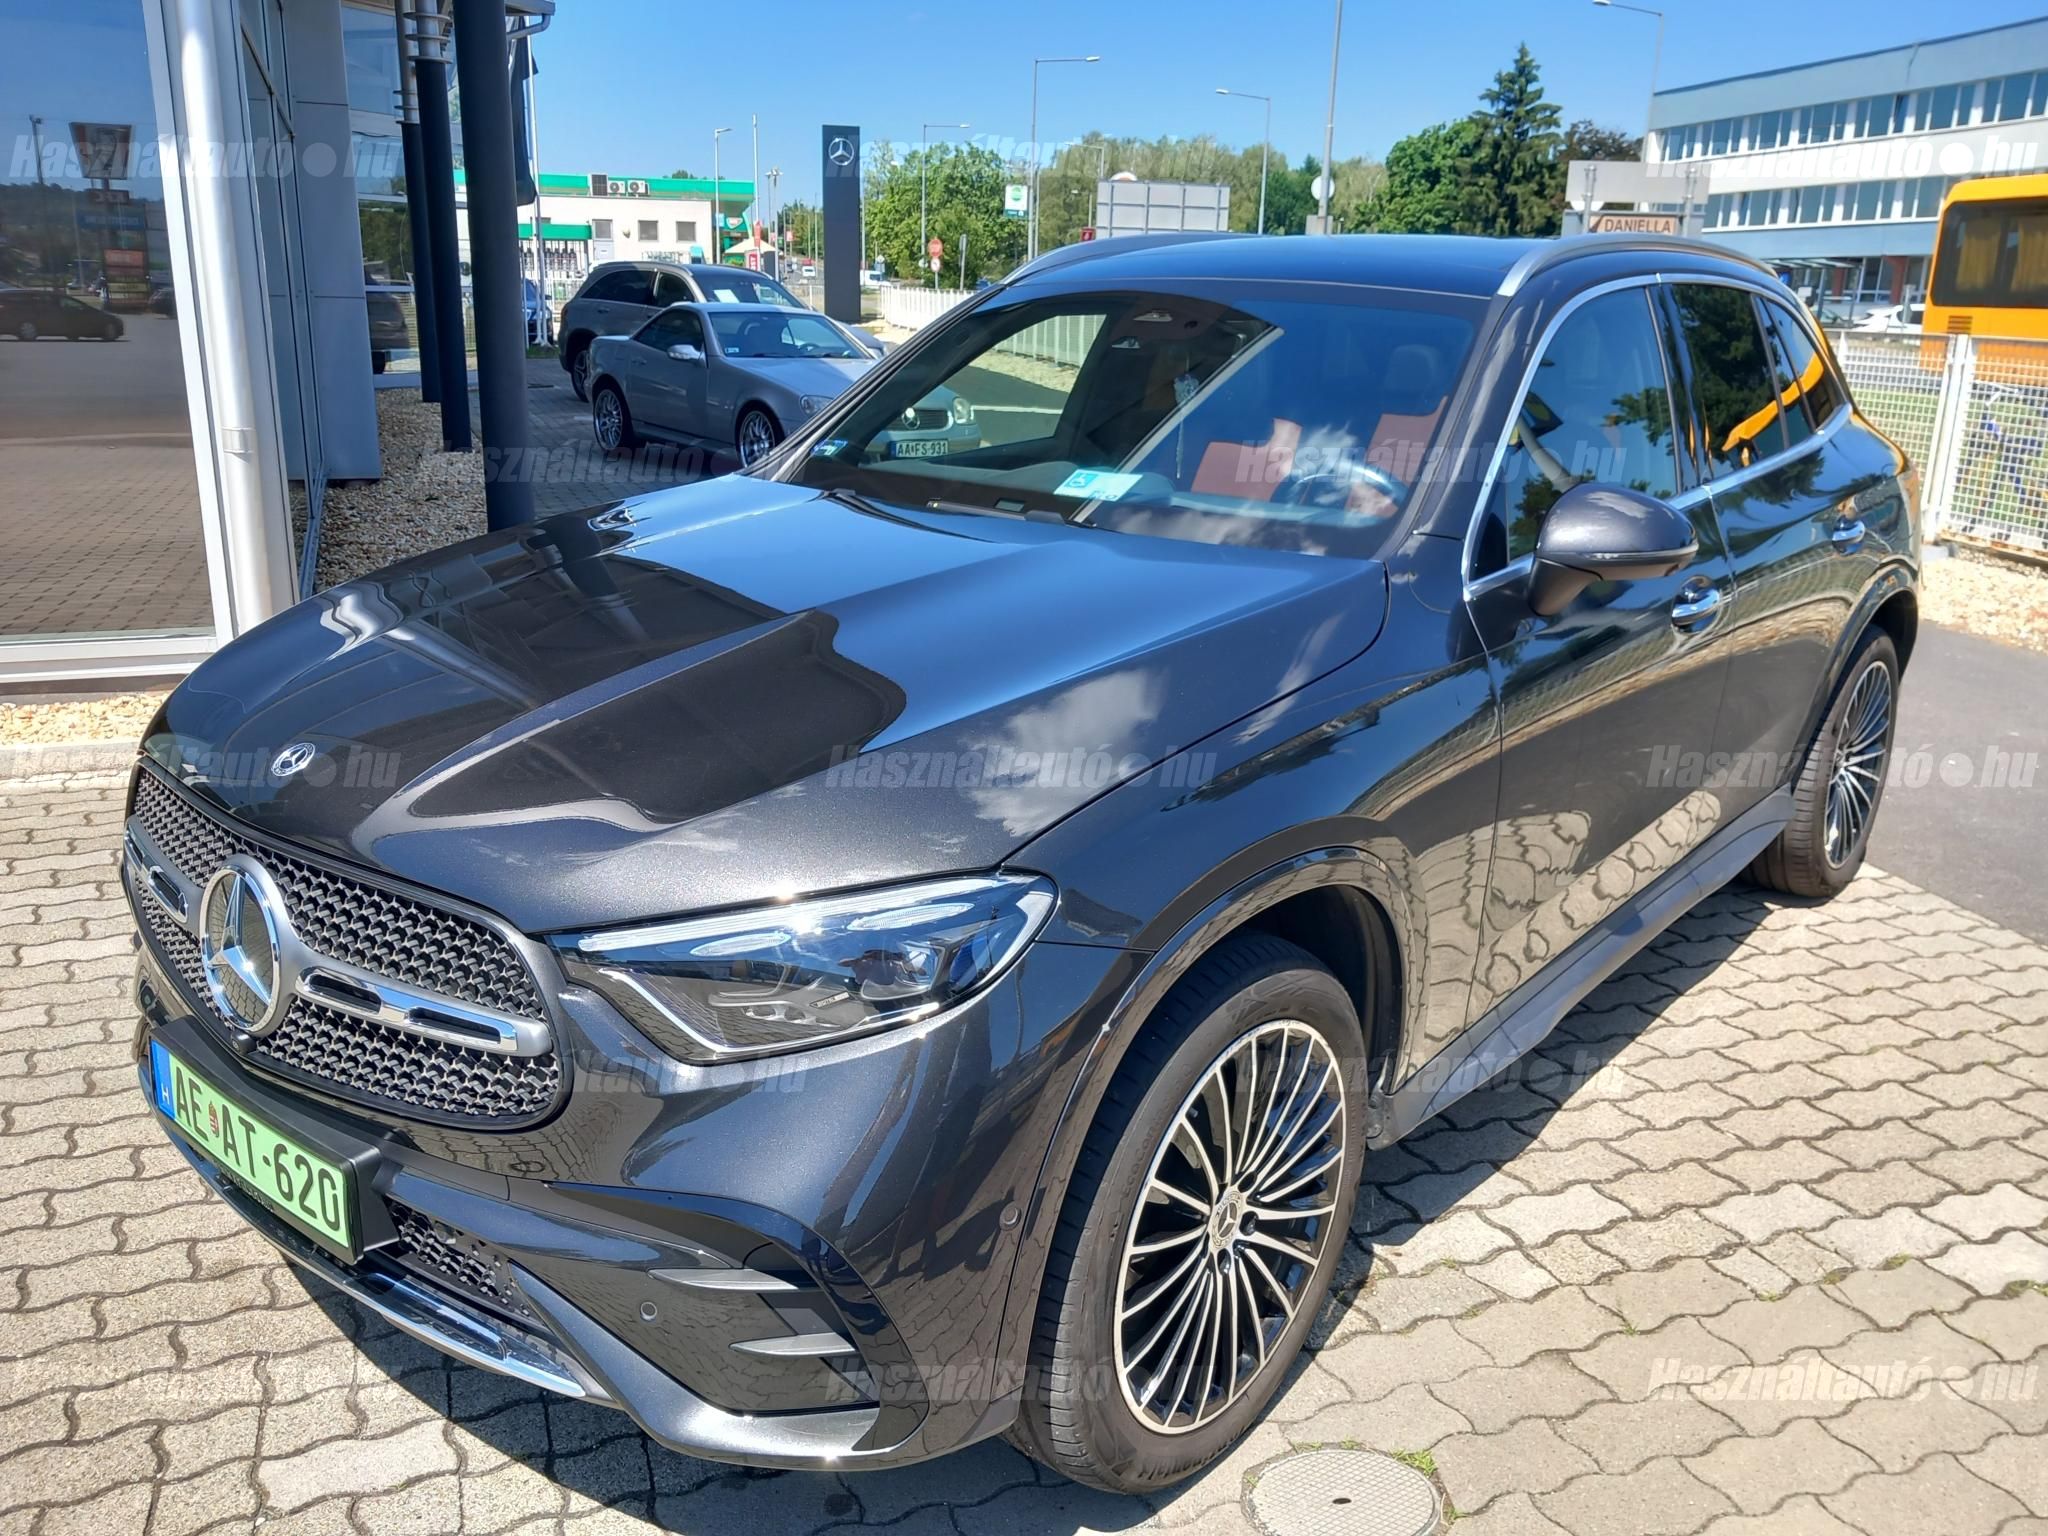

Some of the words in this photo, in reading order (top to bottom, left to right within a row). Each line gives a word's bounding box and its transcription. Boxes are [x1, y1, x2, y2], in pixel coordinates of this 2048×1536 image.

[1604, 217, 1671, 233] DANIELLA
[897, 443, 911, 456] AA
[161, 1084, 170, 1105] H
[175, 1066, 209, 1142] AE
